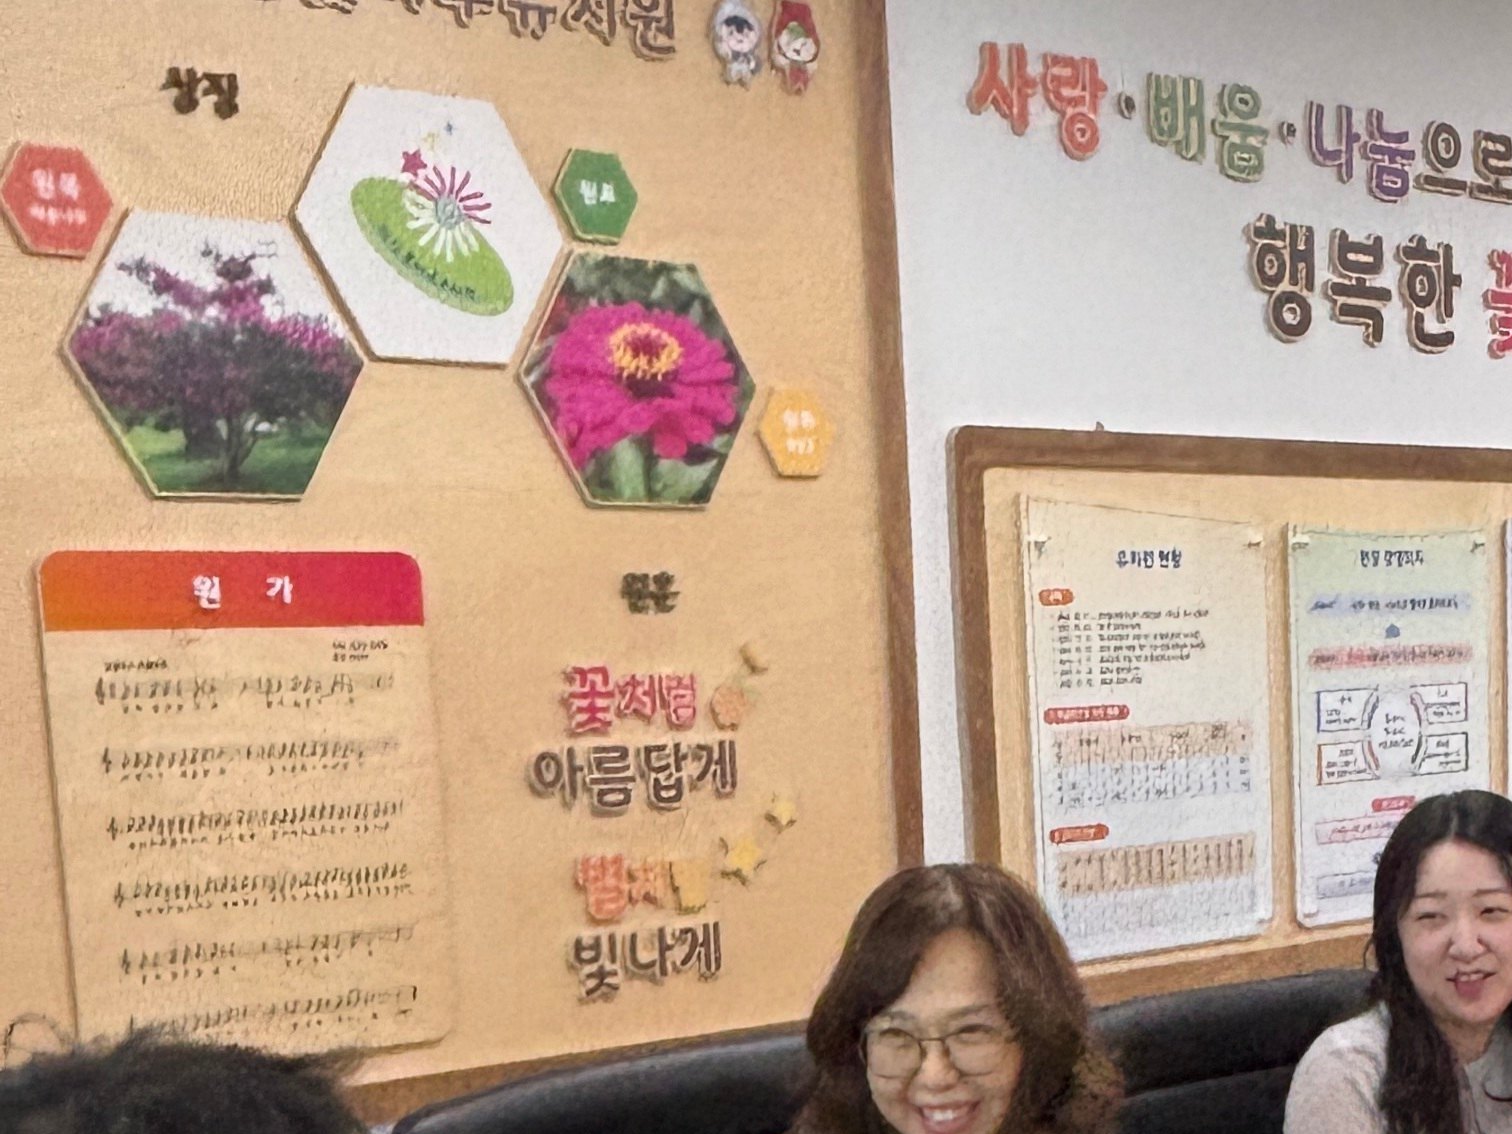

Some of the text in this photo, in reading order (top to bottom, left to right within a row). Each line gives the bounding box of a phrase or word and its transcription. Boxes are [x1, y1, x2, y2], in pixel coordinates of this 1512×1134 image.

[159, 66, 239, 120] 상징
[1243, 212, 1463, 354] 행복한
[562, 664, 698, 736] 꽃처럼
[529, 738, 738, 812] 아름답게
[569, 920, 723, 1003] 빛나게
